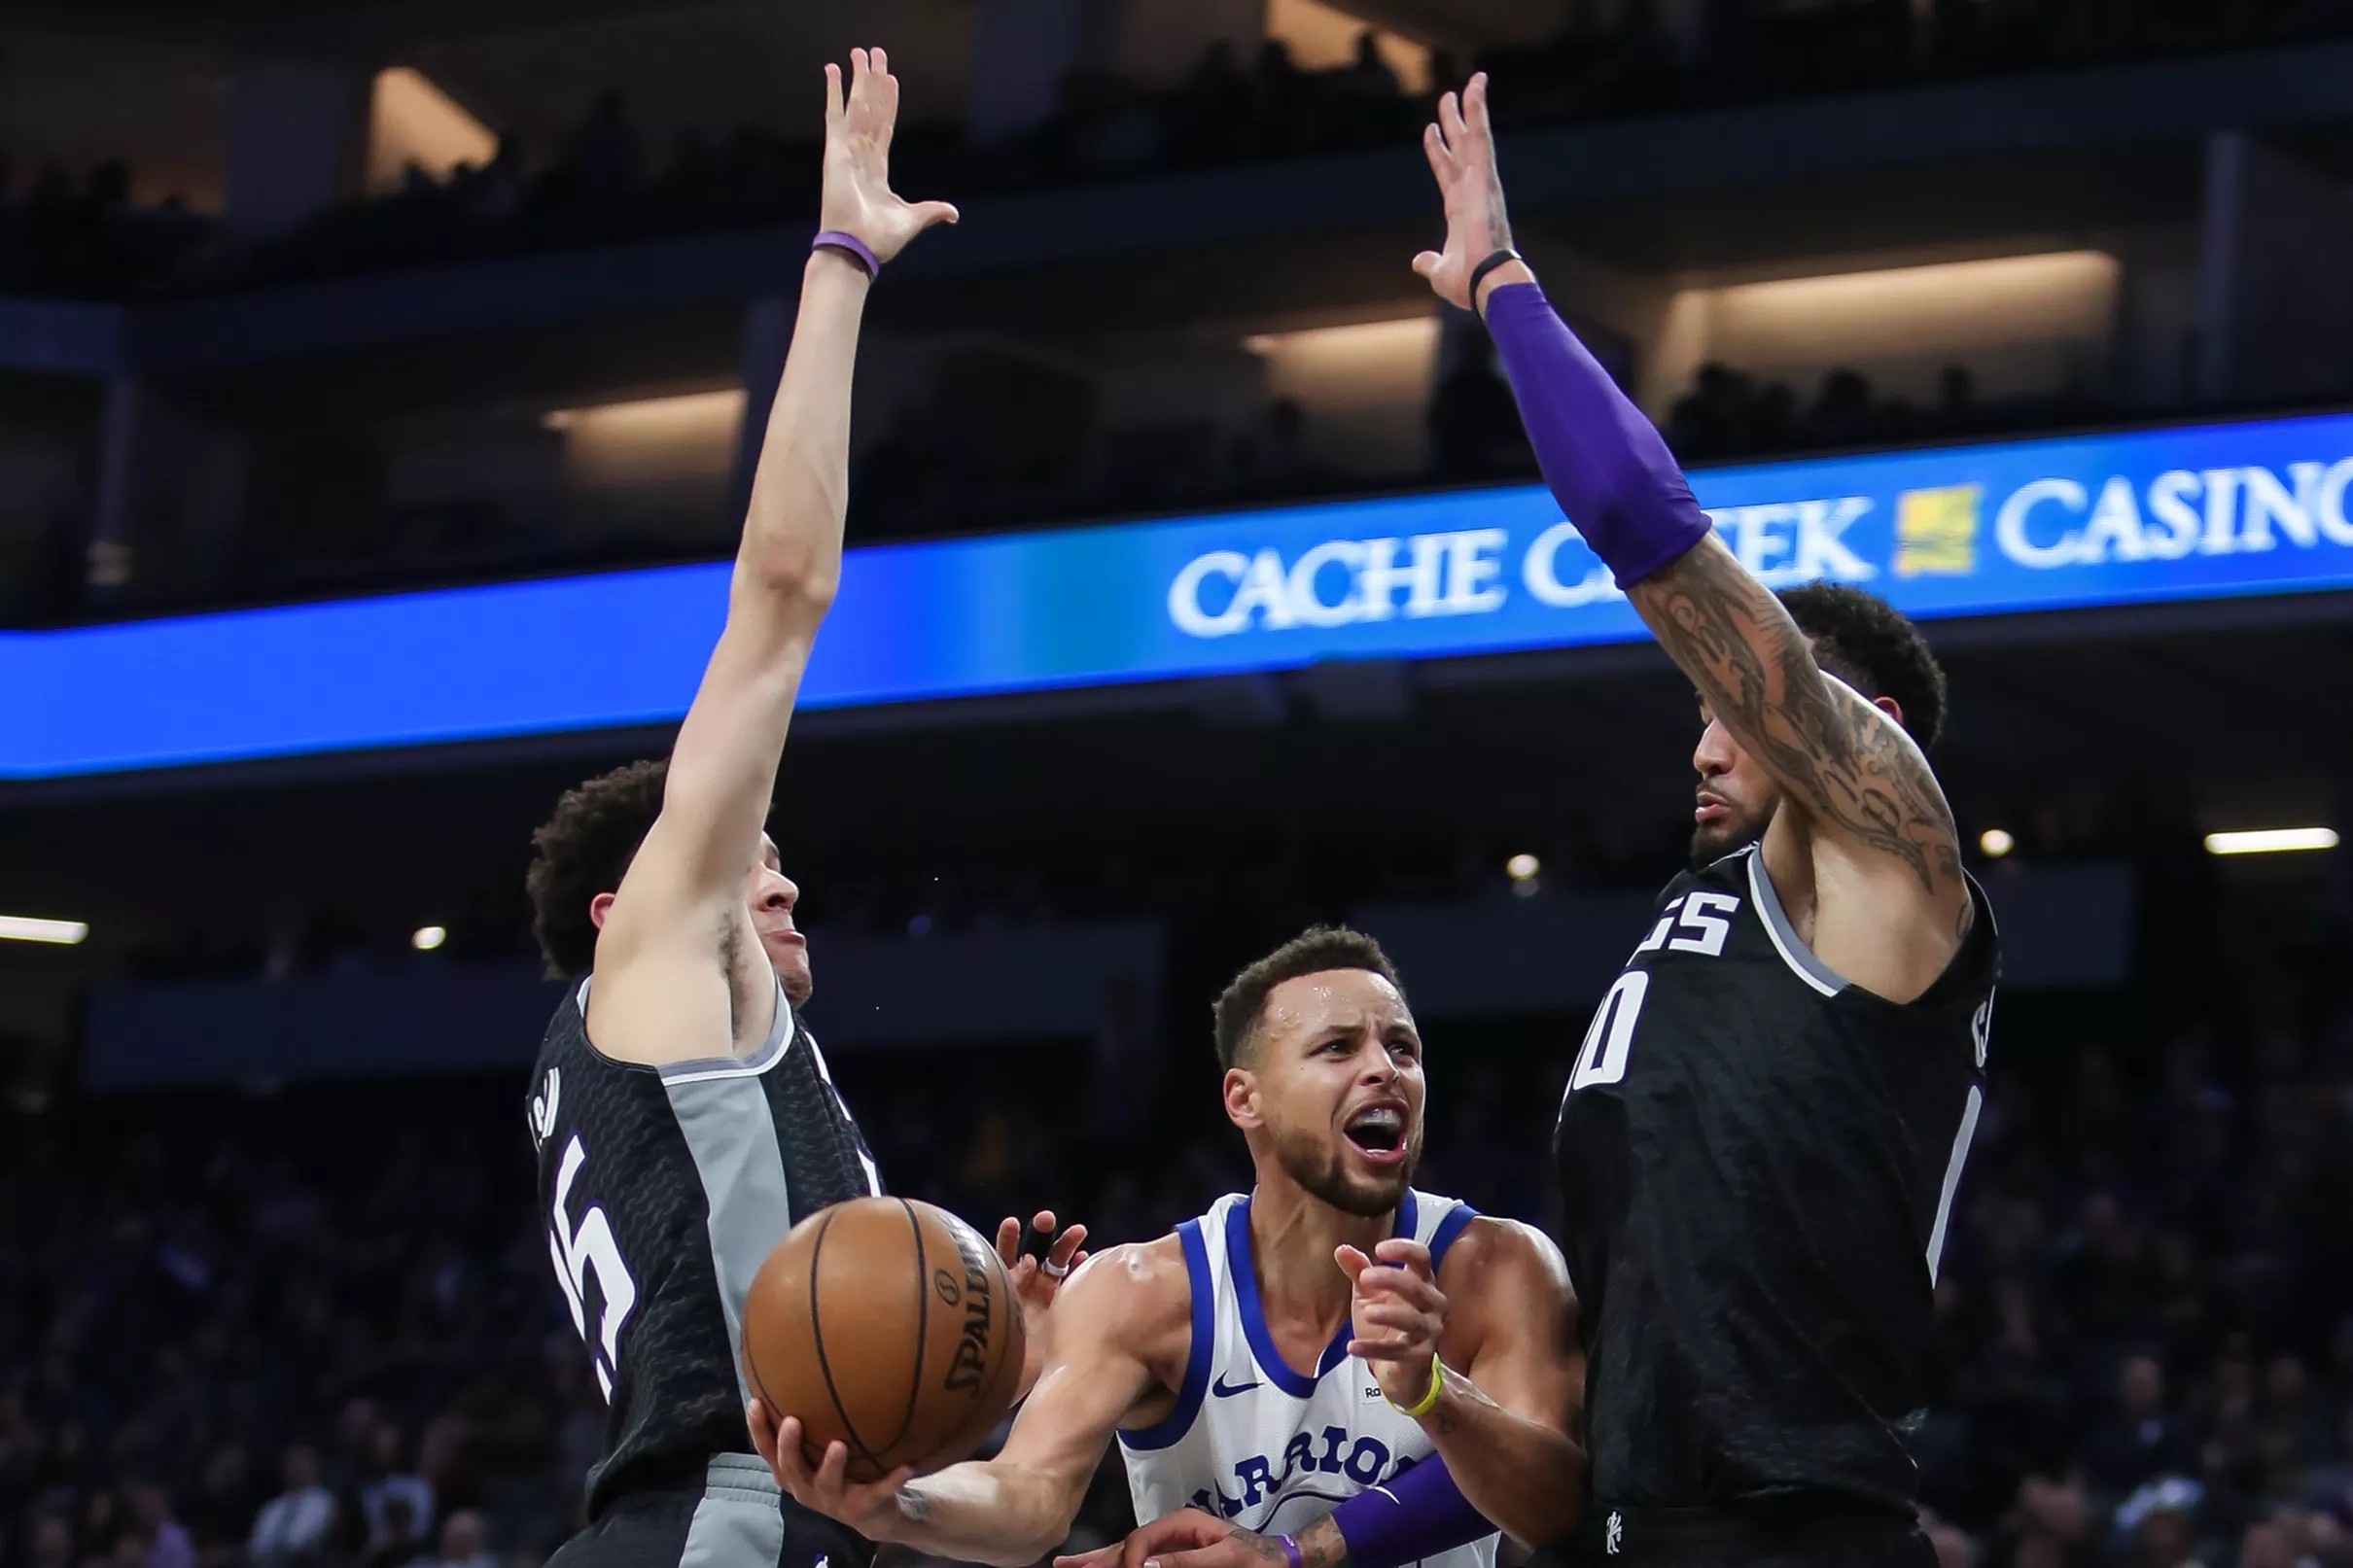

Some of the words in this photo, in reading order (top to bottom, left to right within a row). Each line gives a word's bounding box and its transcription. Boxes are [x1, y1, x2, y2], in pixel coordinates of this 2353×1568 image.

[1167, 527, 1508, 639] CACHE
[1523, 496, 1880, 609] CEK
[1558, 970, 1649, 1123] 0
